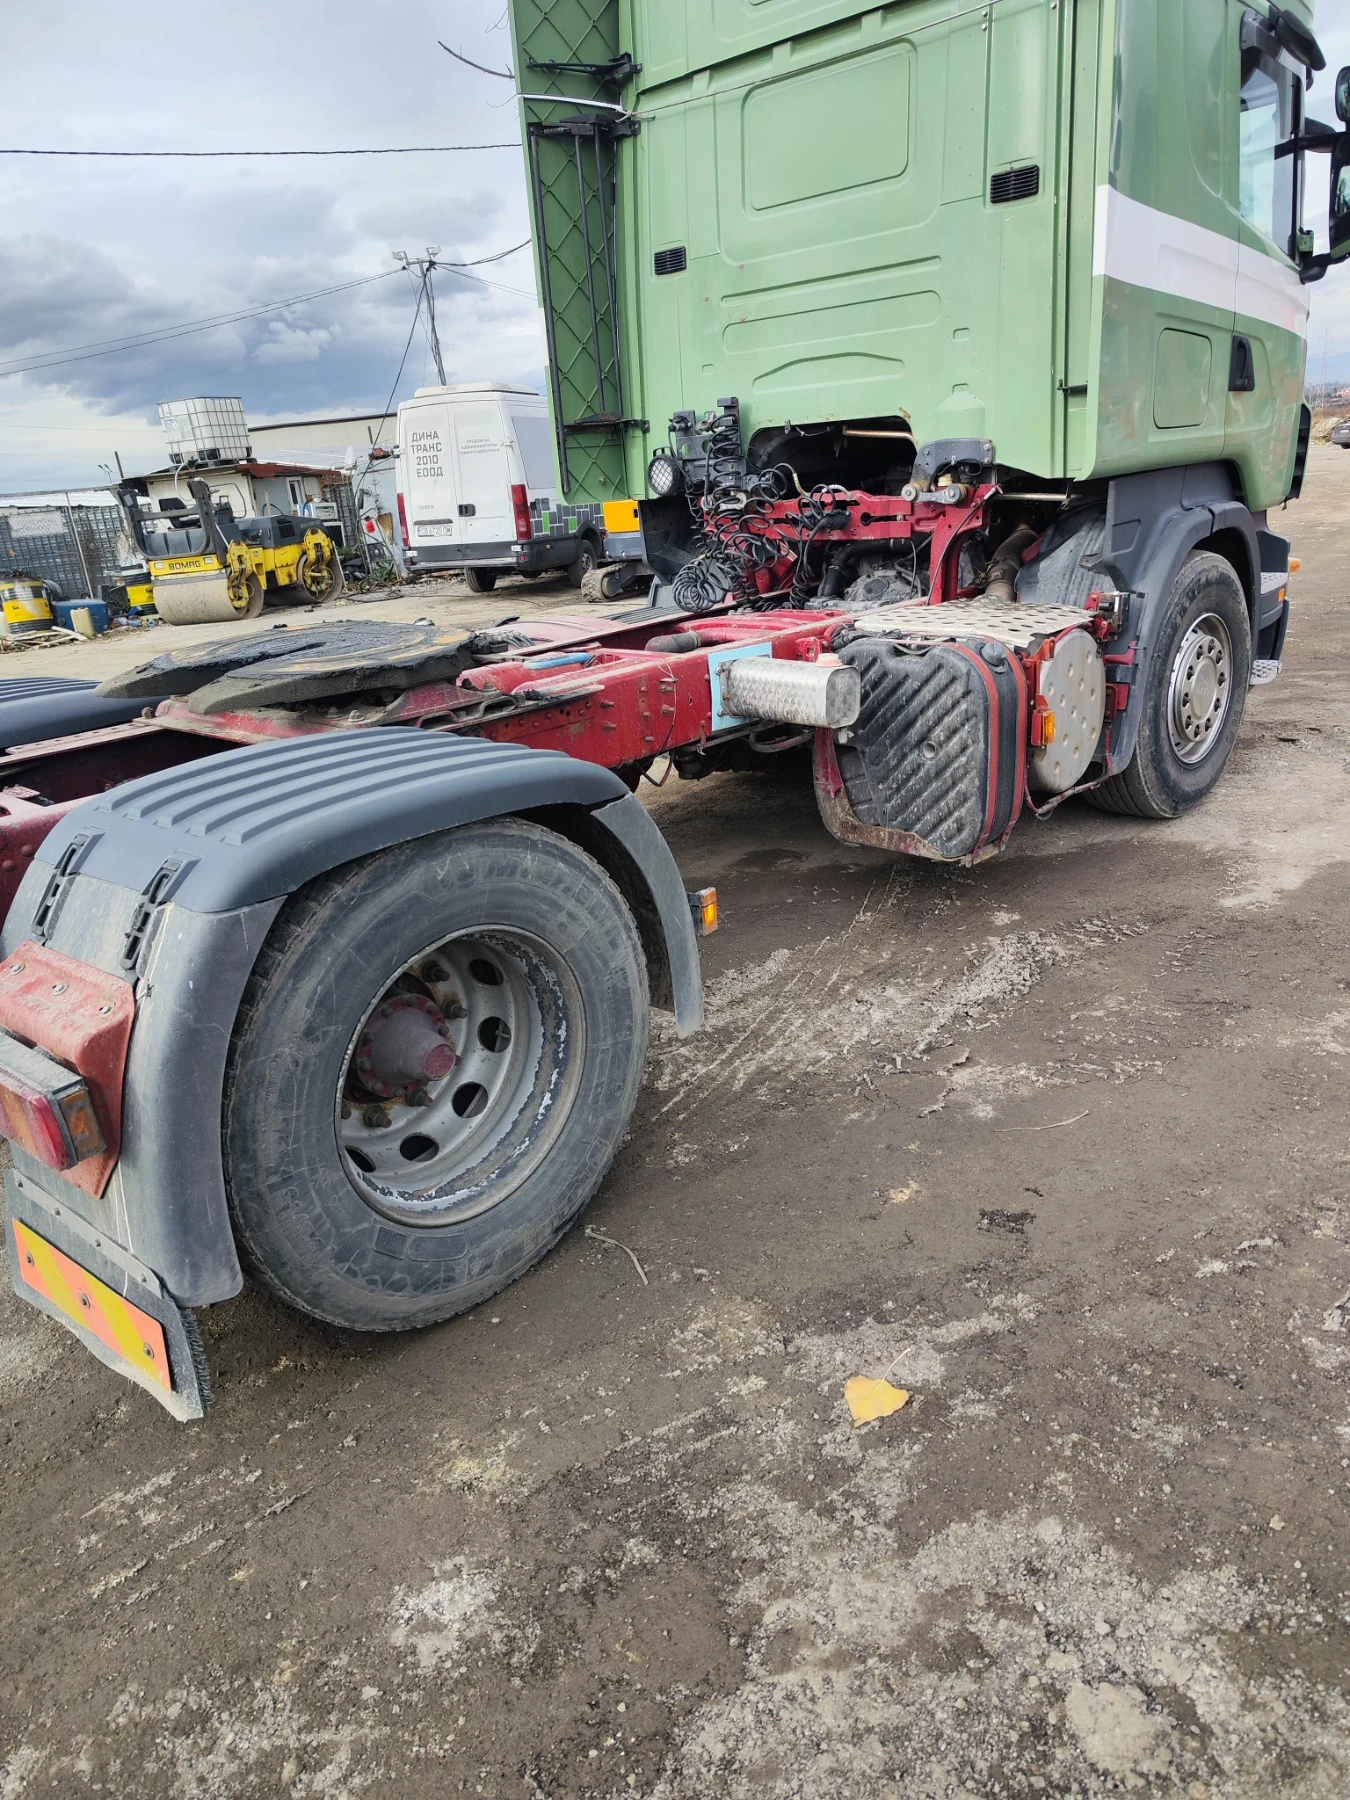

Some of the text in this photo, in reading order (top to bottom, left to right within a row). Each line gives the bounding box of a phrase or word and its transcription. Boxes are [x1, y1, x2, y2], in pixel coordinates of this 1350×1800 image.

[412, 430, 440, 443] ДИНА
[410, 442, 442, 454] ТРАНС
[416, 455, 439, 466] 2010
[416, 466, 444, 478] ЕООД
[168, 561, 200, 570] BOMAG
